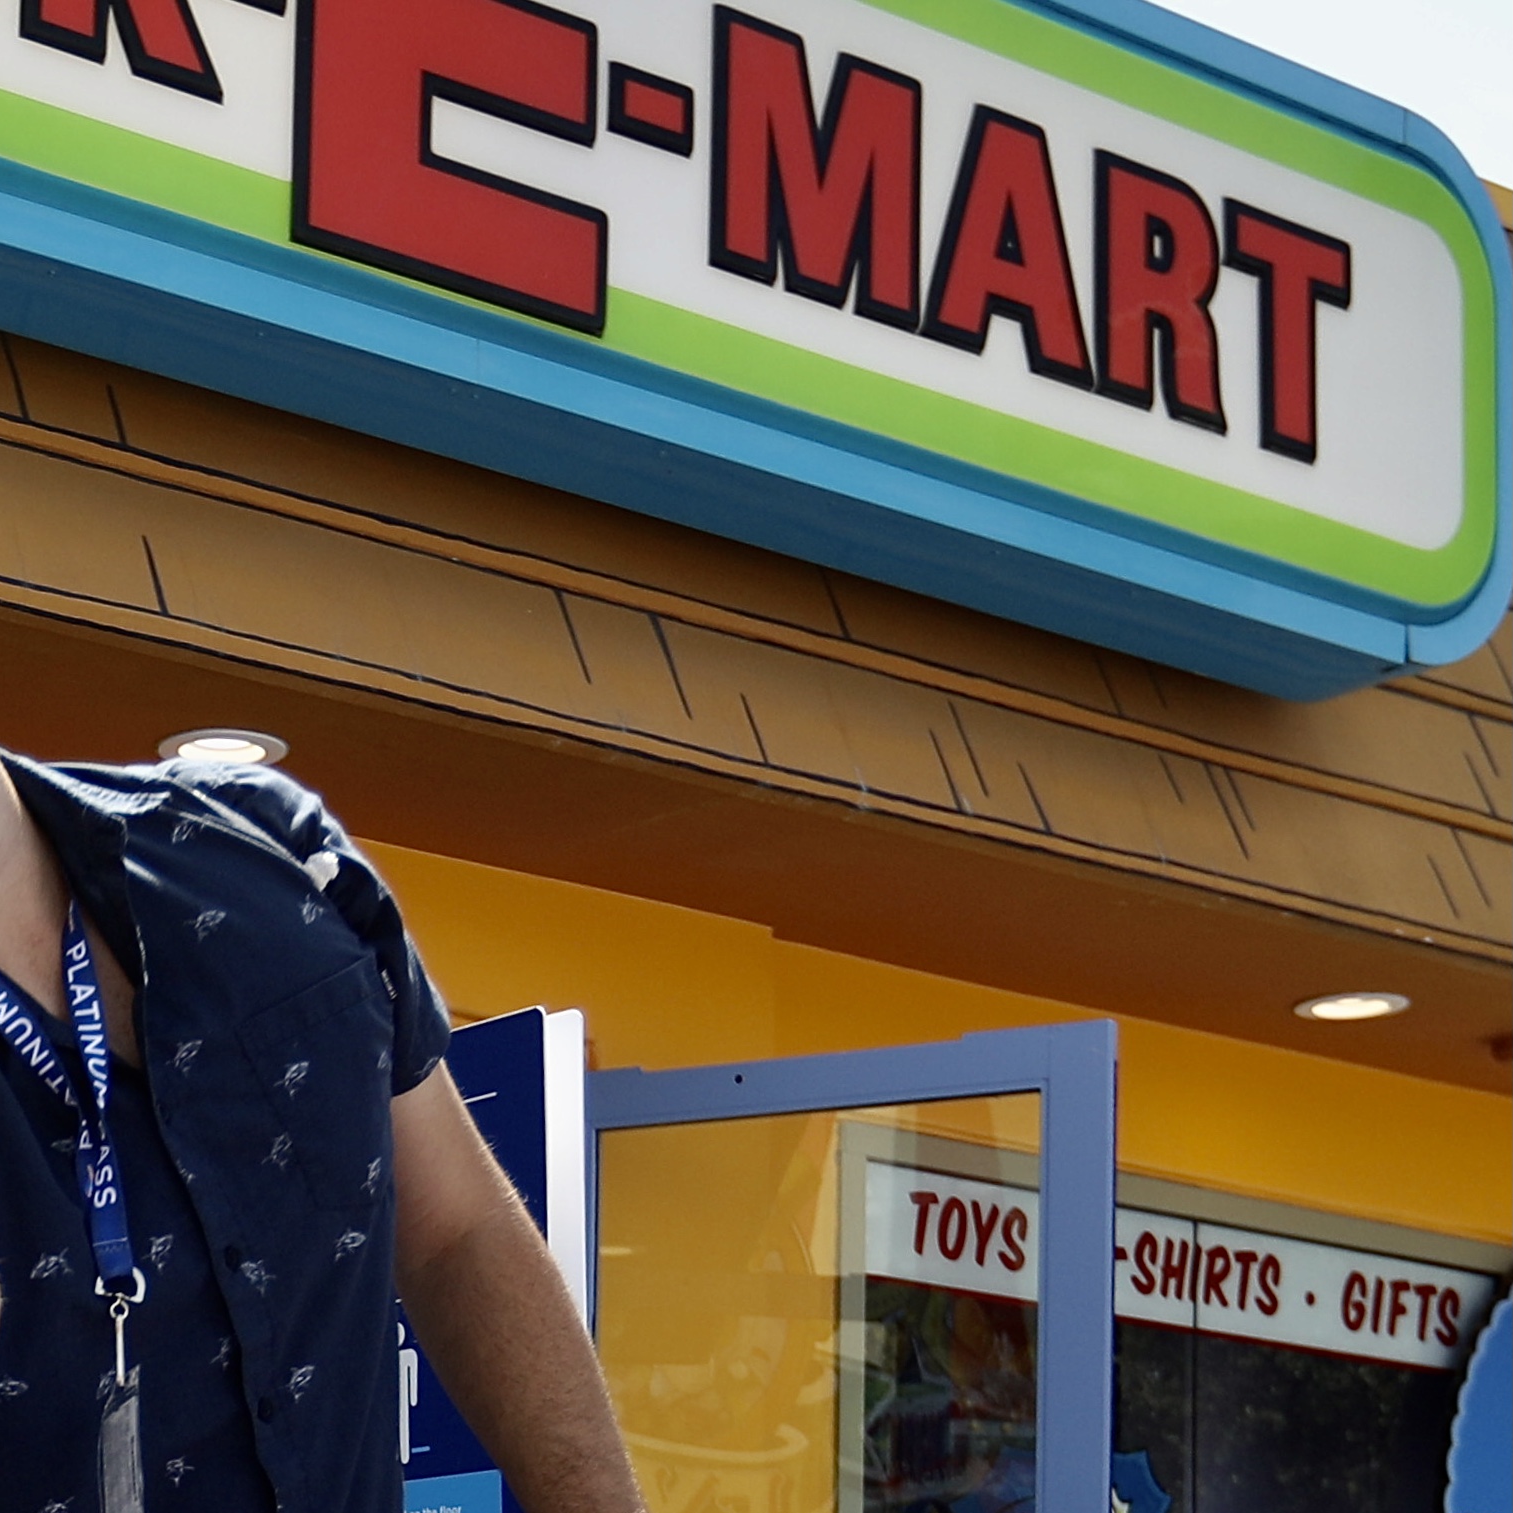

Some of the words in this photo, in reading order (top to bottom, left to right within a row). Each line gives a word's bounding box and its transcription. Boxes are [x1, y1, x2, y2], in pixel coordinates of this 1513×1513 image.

[19, 0, 1352, 465] E-MART
[93, 1121, 117, 1209] ASS
[908, 1190, 1028, 1272] TOYS
[1114, 1229, 1282, 1317] -SHIRTS
[1341, 1270, 1462, 1348] GIFTS
